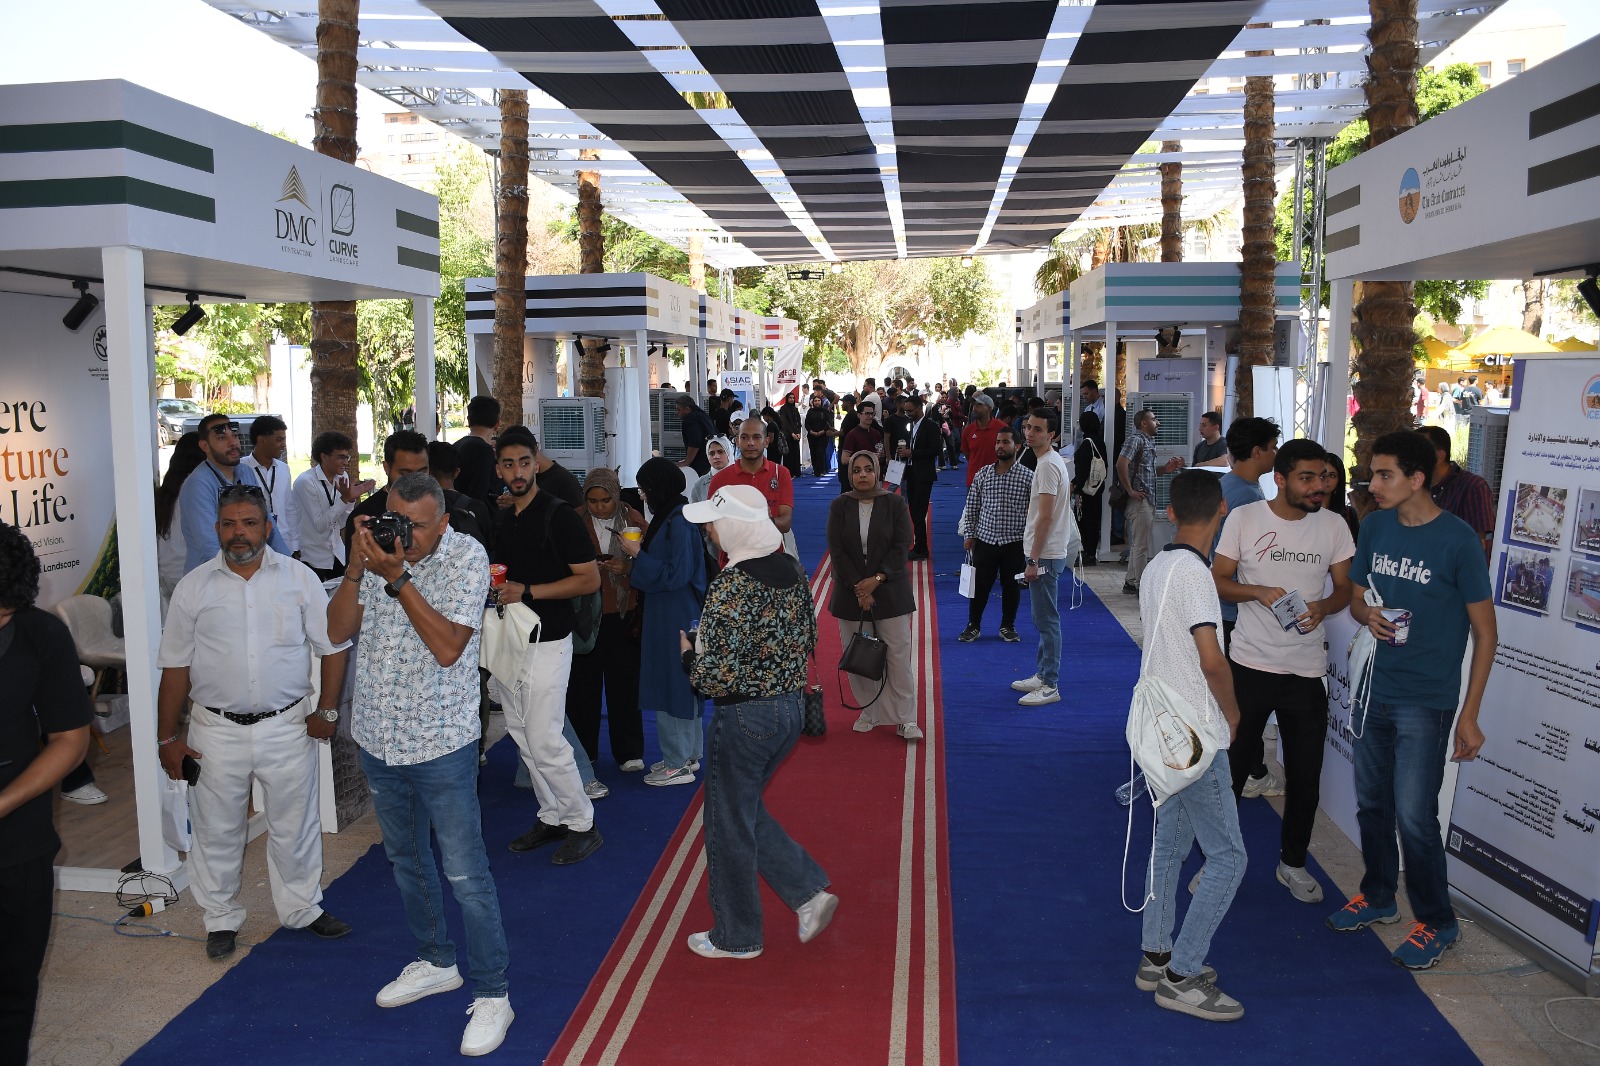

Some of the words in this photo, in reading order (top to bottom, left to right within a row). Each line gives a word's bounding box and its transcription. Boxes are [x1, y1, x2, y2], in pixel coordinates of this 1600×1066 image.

[275, 208, 317, 246] DMC
[281, 245, 313, 258] CONTRACTING
[329, 239, 358, 259] CURVE
[329, 256, 359, 267] LANDSCAPE
[729, 376, 751, 384] SIAC
[1144, 371, 1161, 381] dar
[0, 399, 48, 435] ere
[1586, 410, 1600, 420] ICE
[0, 442, 70, 483] ture
[11, 482, 75, 528] Life.
[43, 536, 65, 547] Vision.
[1254, 531, 1322, 565] Fielmann
[43, 558, 80, 573] Landscape
[1371, 552, 1398, 577] Lake
[1398, 557, 1432, 585] Erie
